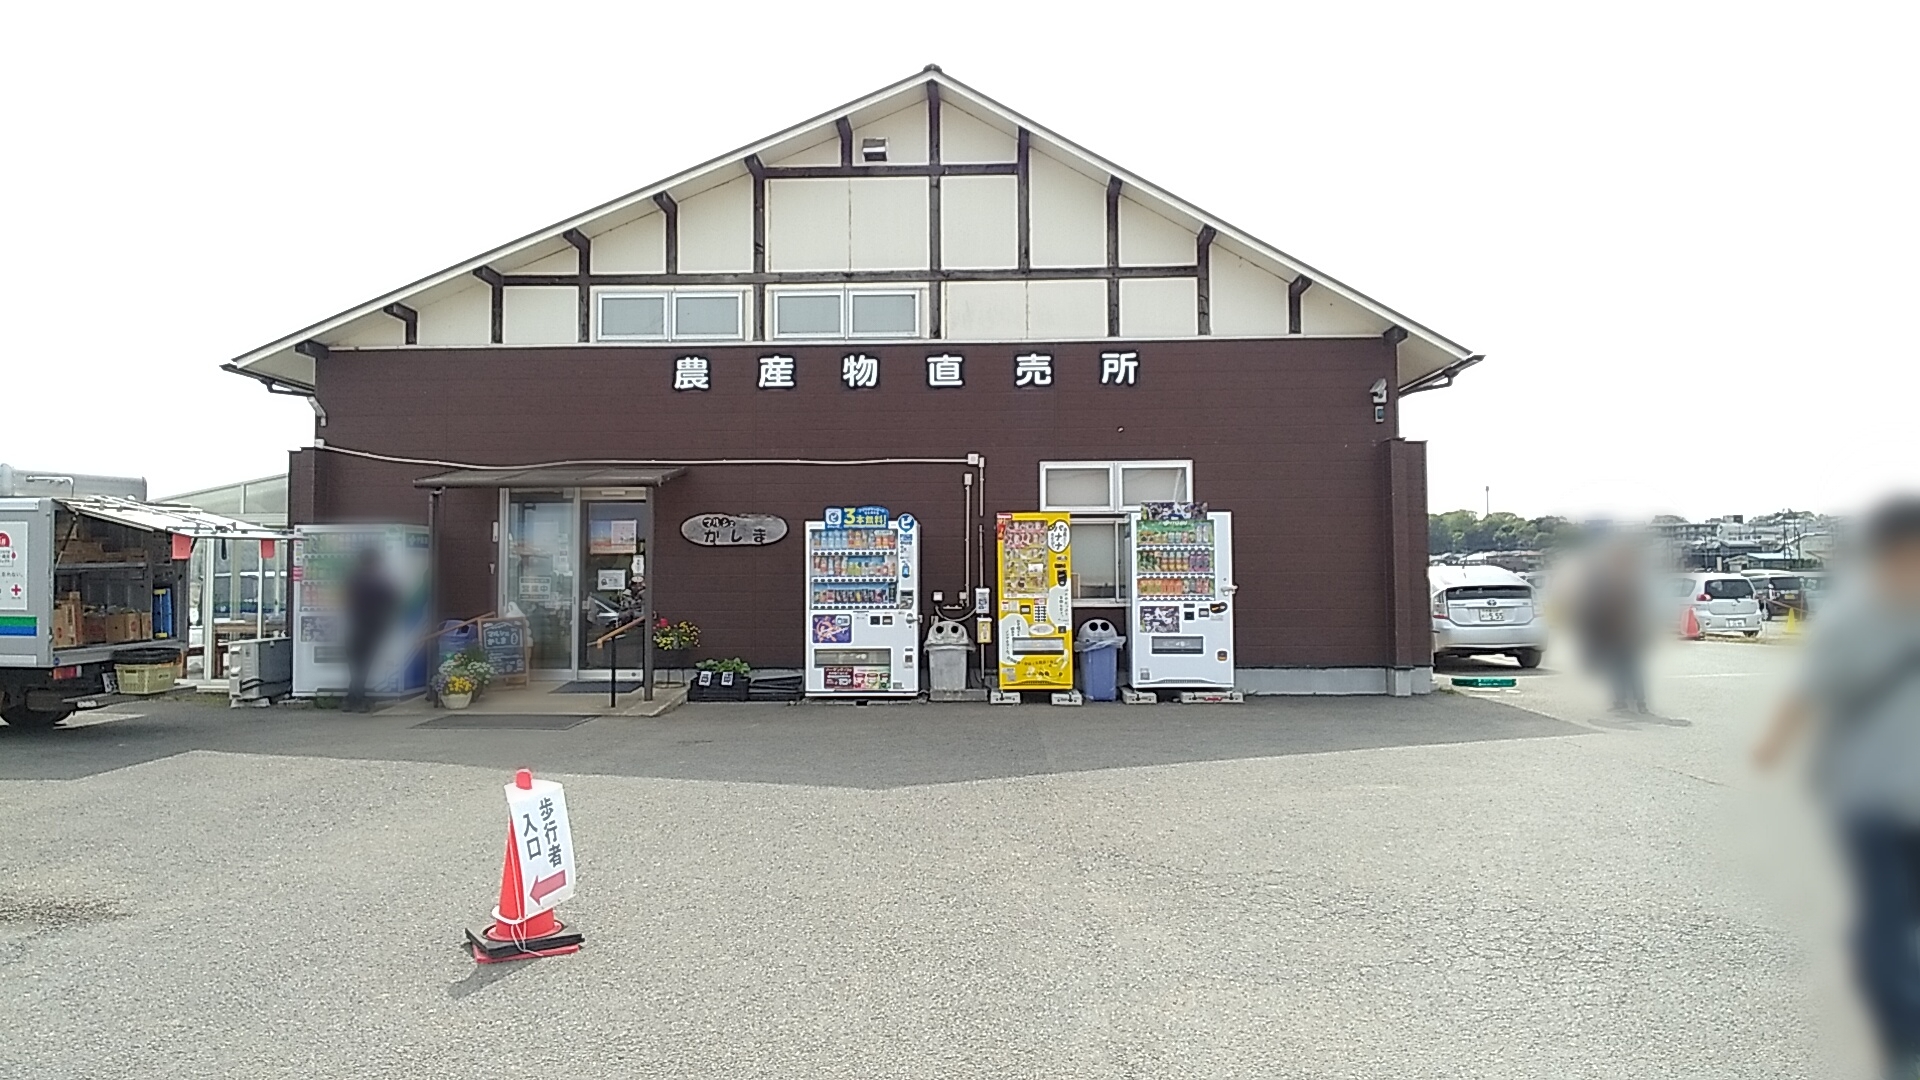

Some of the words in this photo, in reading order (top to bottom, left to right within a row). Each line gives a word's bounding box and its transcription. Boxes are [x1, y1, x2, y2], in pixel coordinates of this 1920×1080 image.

[675, 351, 1138, 390] 農産物直売所
[704, 528, 767, 543] かしま
[1054, 525, 1064, 550] バナナ
[522, 813, 542, 861] 入口
[539, 797, 562, 868] 歩行者
